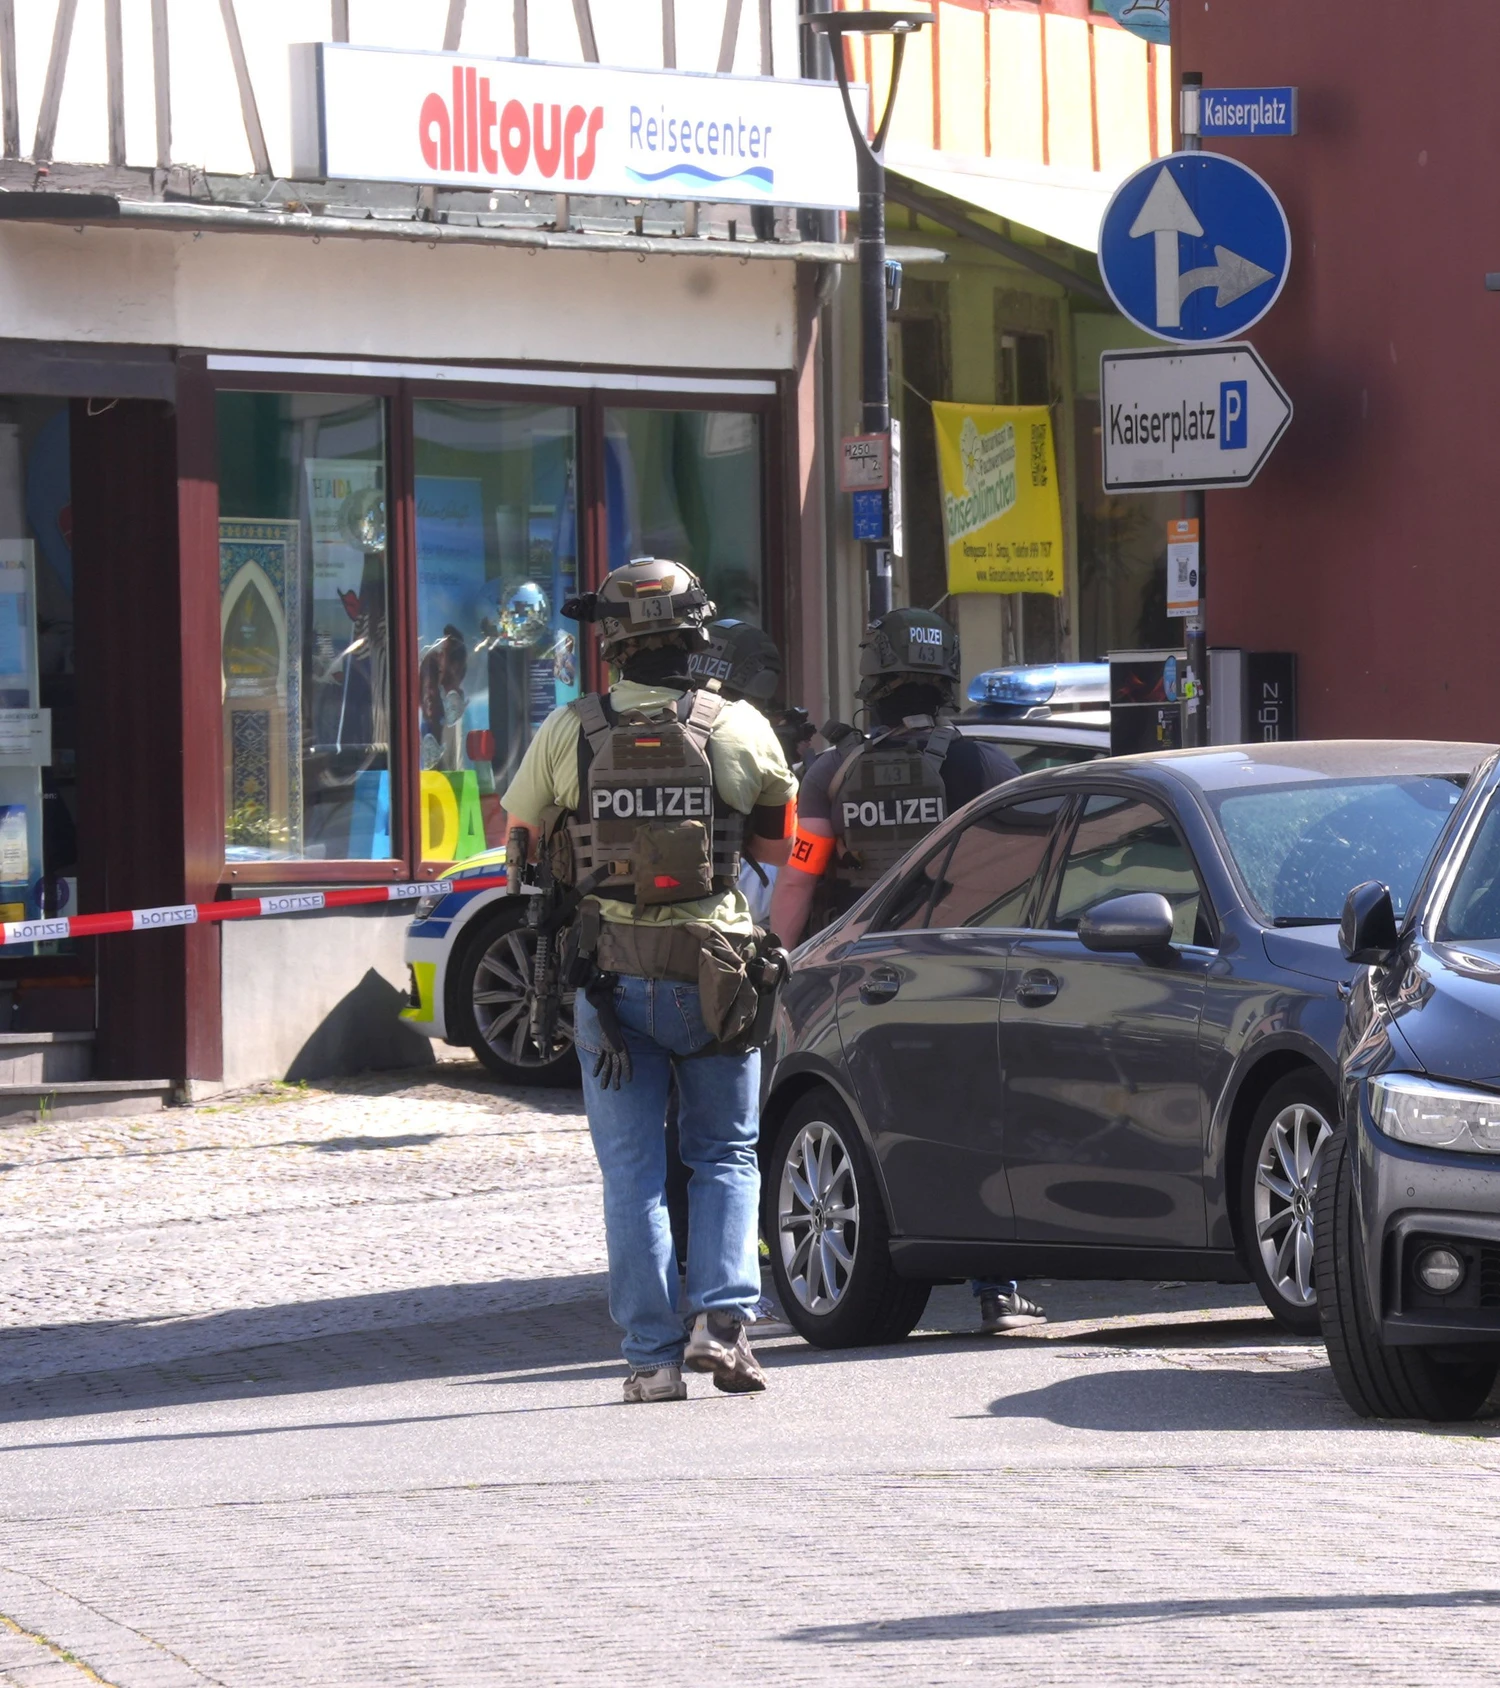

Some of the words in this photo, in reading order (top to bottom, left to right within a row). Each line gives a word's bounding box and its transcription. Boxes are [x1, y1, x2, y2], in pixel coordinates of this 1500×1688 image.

[419, 65, 604, 180] alltours
[630, 105, 772, 159] Reisecenter
[1204, 96, 1286, 133] Kaiserplatz
[1110, 401, 1216, 453] Kaiserplatz
[909, 627, 943, 646] POLIZEI
[687, 653, 733, 680] OLIZEI
[592, 786, 712, 819] POLIZEI
[842, 797, 944, 828] POLIZEI
